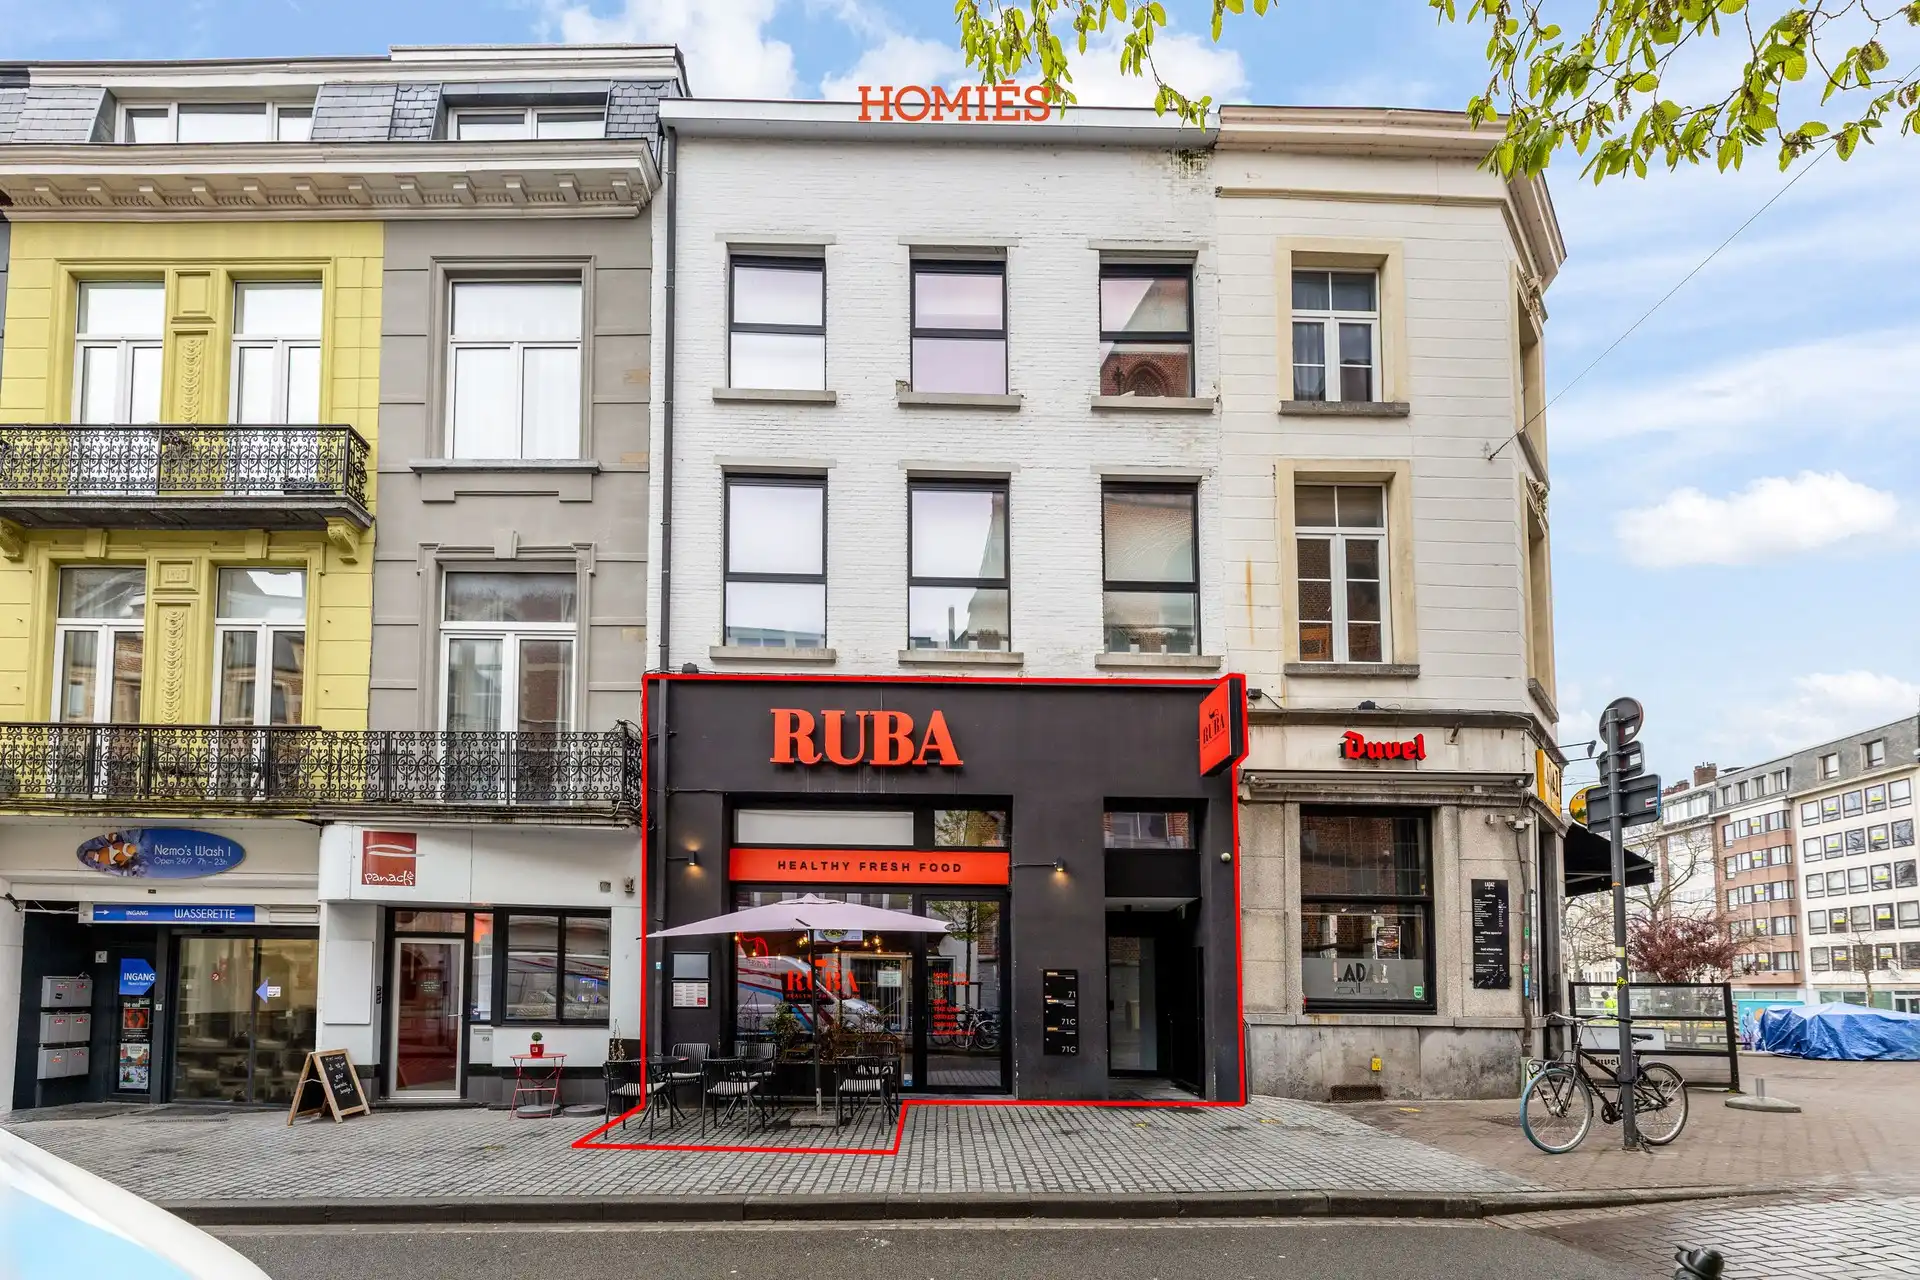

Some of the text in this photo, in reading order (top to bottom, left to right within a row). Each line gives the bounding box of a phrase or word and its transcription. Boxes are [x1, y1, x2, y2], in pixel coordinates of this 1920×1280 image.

[1203, 713, 1225, 745] RUBA
[769, 708, 964, 766] RUBA
[1340, 730, 1427, 761] Duvel
[154, 844, 192, 857] Nemo's
[195, 844, 224, 857] Wash
[154, 857, 174, 865] Open
[176, 857, 193, 865] 24/7
[197, 857, 207, 865] 7h
[777, 861, 962, 873] HEALTHY FRESH FOOD
[174, 908, 236, 920] WASSERETTE
[123, 972, 155, 981] INGANG
[1067, 990, 1076, 998] 71
[1061, 1018, 1076, 1026] 71C
[1061, 1045, 1077, 1053] 71C
